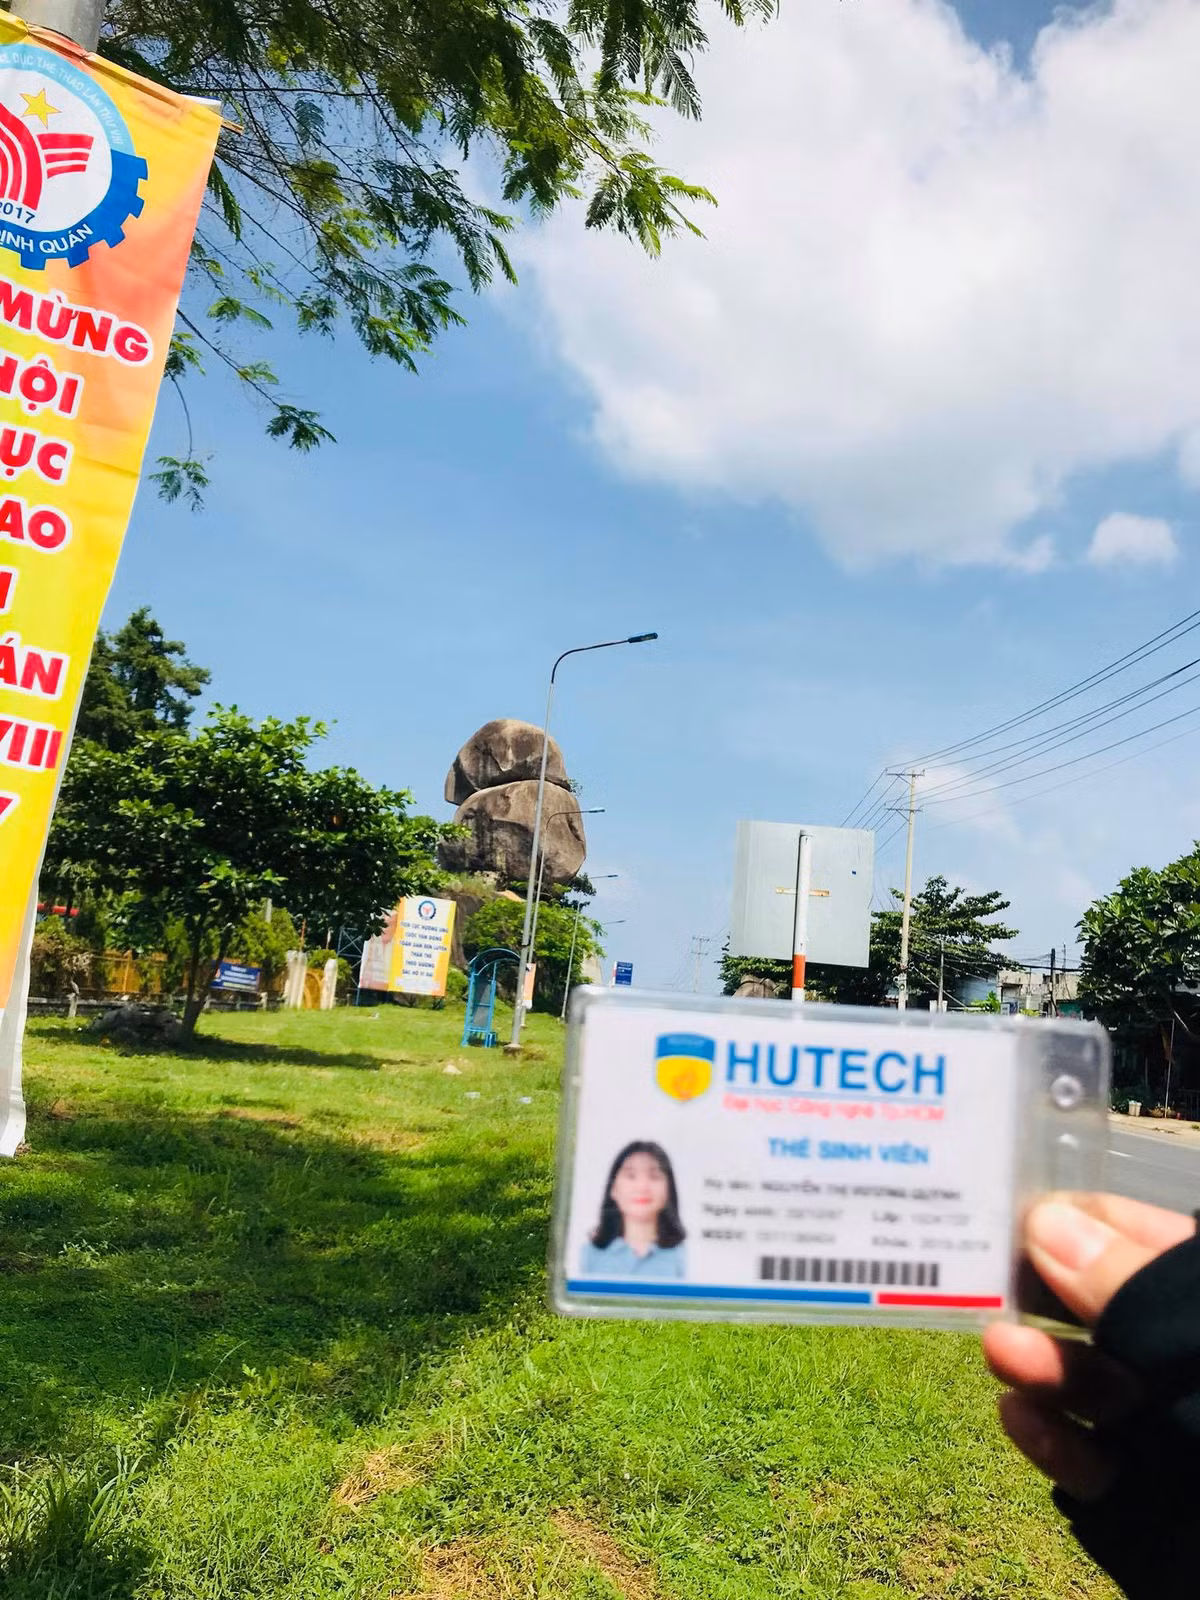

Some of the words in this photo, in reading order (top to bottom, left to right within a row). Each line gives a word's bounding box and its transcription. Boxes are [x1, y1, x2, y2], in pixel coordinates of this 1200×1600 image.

[0, 229, 34, 253] ỊNH
[39, 223, 93, 254] QUÁN
[0, 281, 149, 362] MỪNG
[726, 1040, 945, 1096] HUTECH
[818, 1140, 871, 1161] SINH
[879, 1141, 929, 1164] VIÊN
